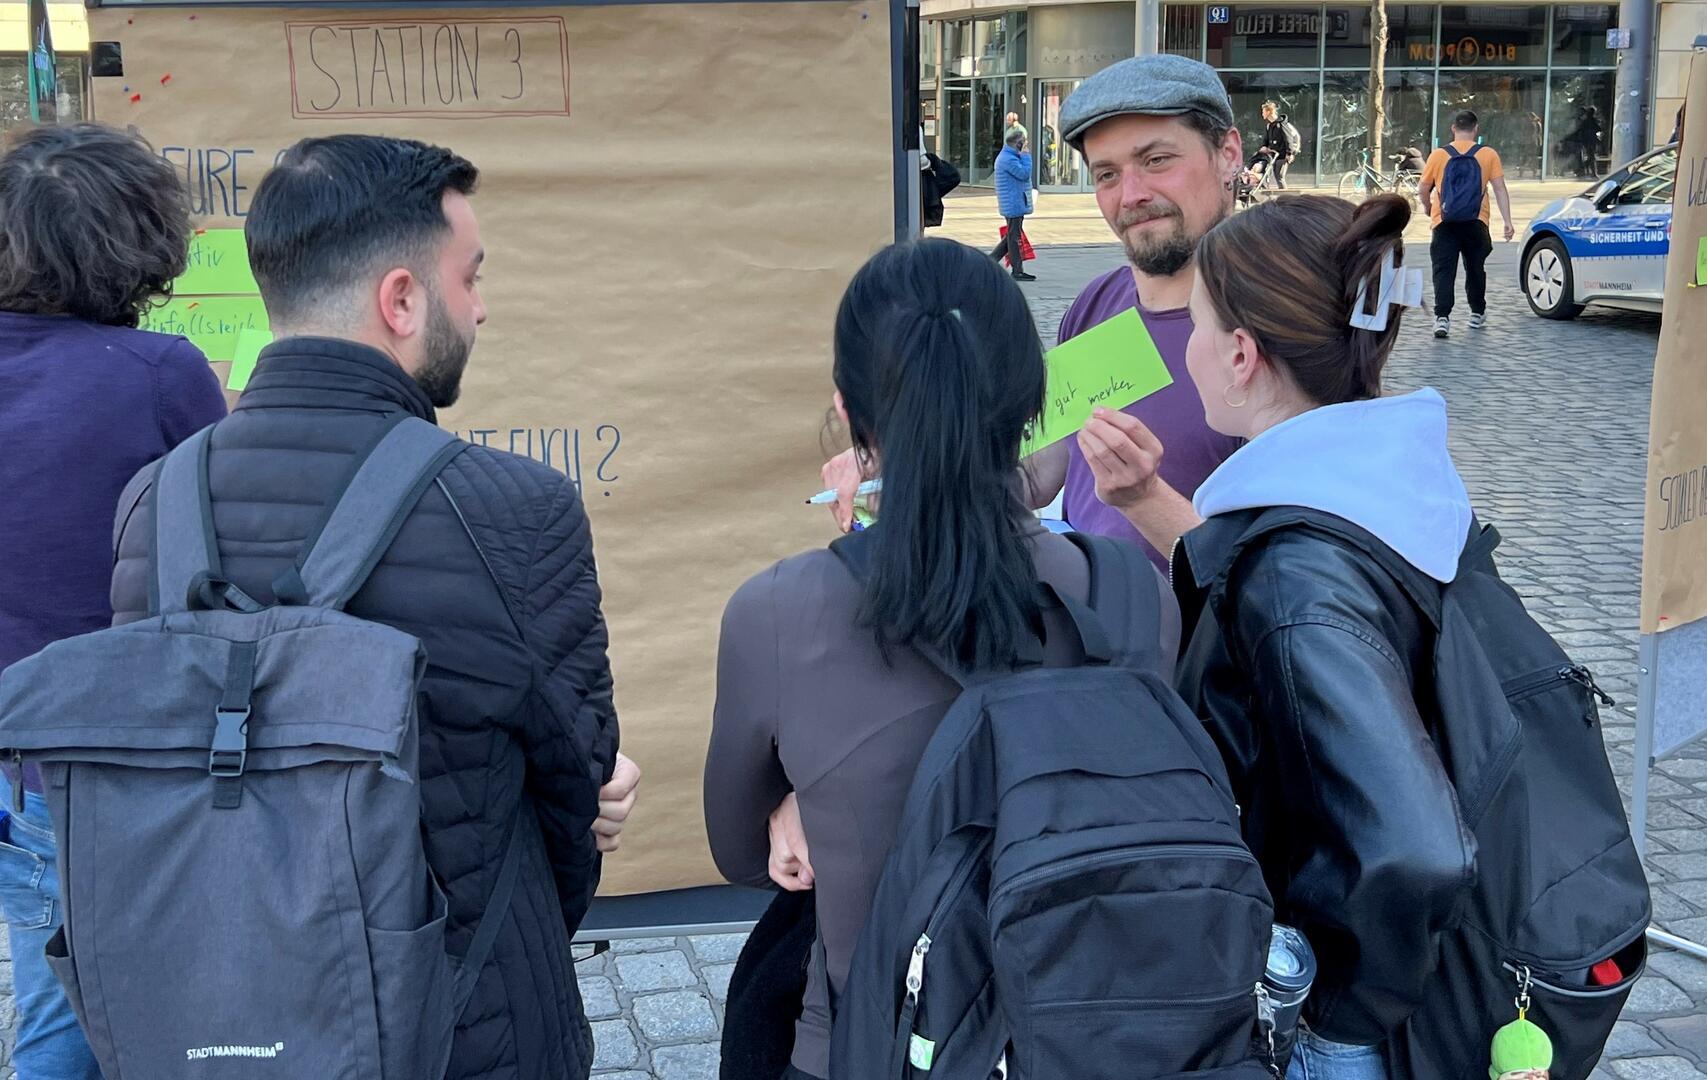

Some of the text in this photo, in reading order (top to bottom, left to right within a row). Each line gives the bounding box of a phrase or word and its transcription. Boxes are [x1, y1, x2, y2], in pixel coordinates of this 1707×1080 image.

[1212, 8, 1225, 19] Q1
[310, 24, 523, 111] STATION 3
[1590, 231, 1641, 244] SICHERHEIT
[1645, 230, 1664, 242] UND
[1055, 381, 1078, 416] gut
